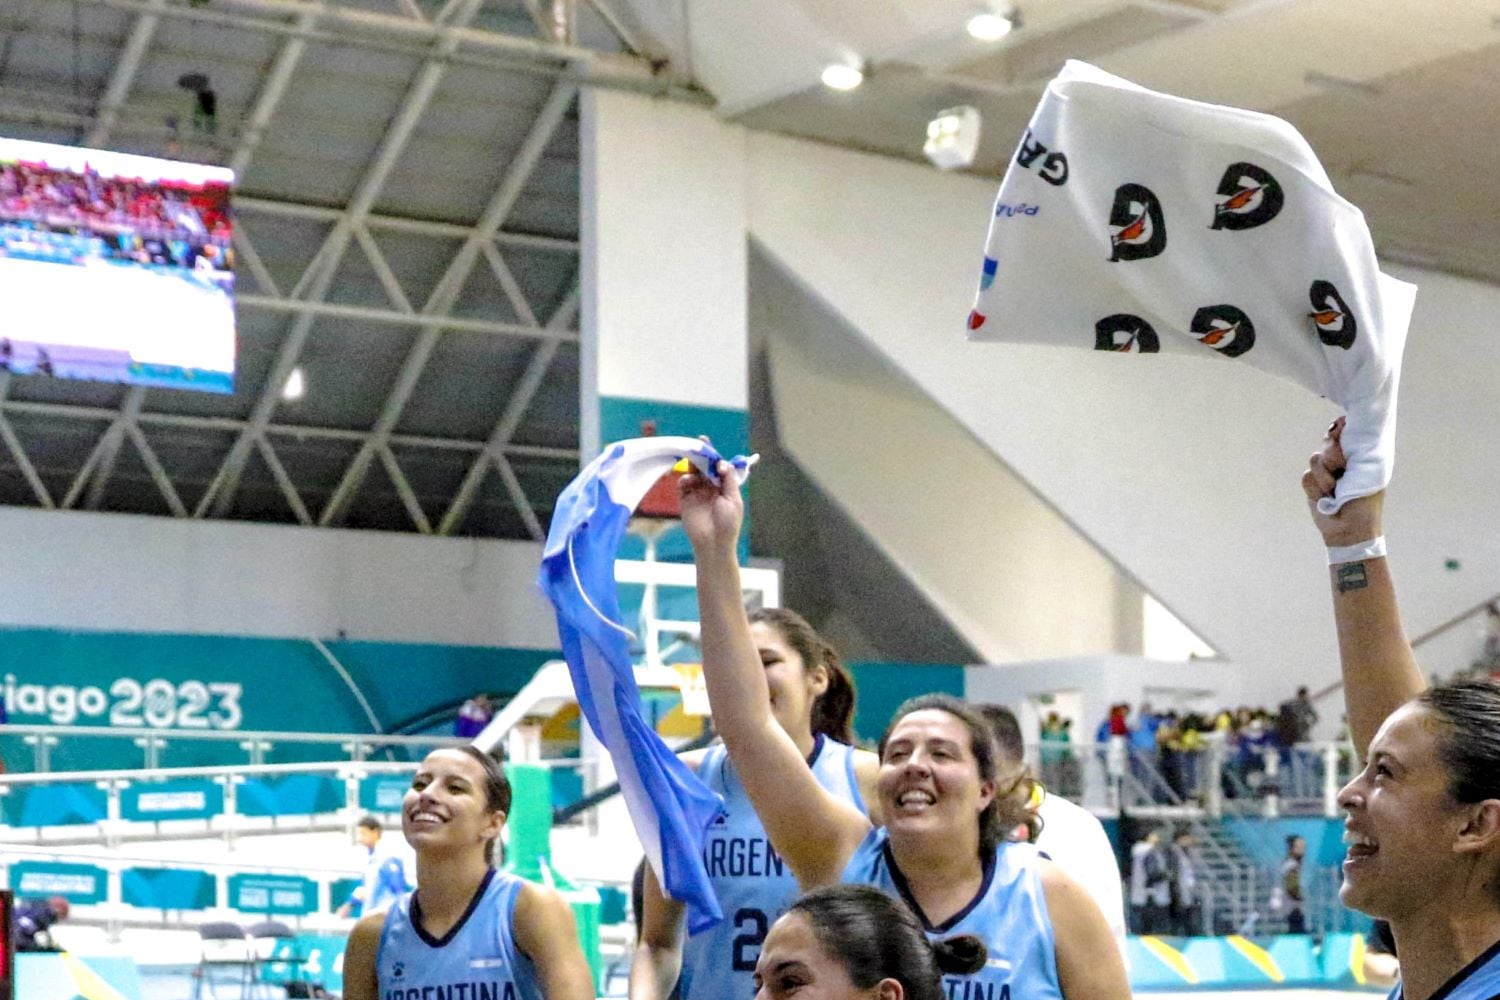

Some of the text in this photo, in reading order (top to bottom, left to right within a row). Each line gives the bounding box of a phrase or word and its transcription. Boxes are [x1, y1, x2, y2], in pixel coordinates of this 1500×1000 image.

[0, 673, 242, 729] iago 2023
[732, 908, 770, 971] 2
